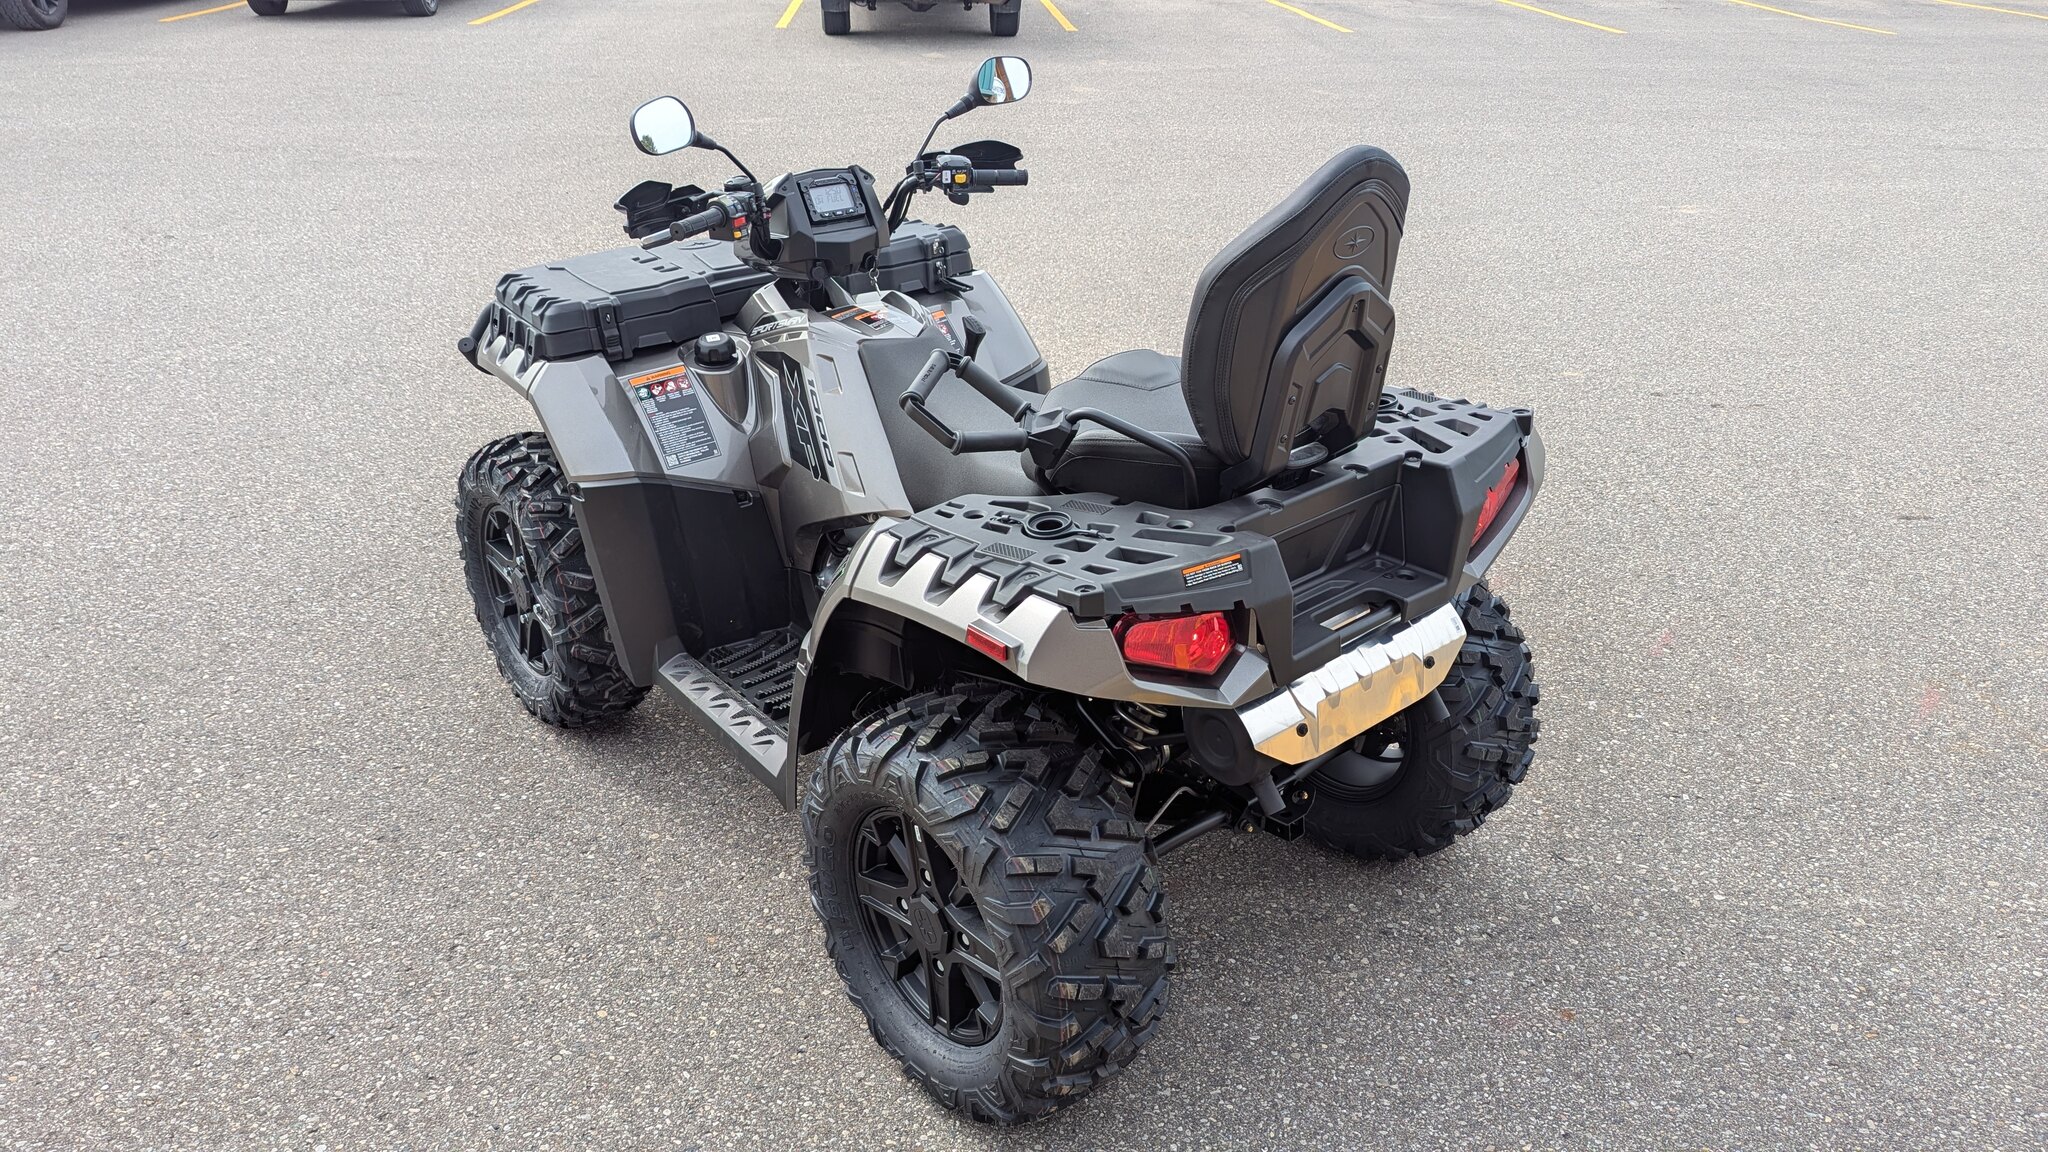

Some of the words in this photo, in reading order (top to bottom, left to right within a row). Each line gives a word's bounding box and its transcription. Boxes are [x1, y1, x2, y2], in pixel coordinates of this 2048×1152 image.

[749, 315, 807, 337] SPORTSMAN
[782, 359, 822, 482] XP
[807, 378, 835, 469] 1000
